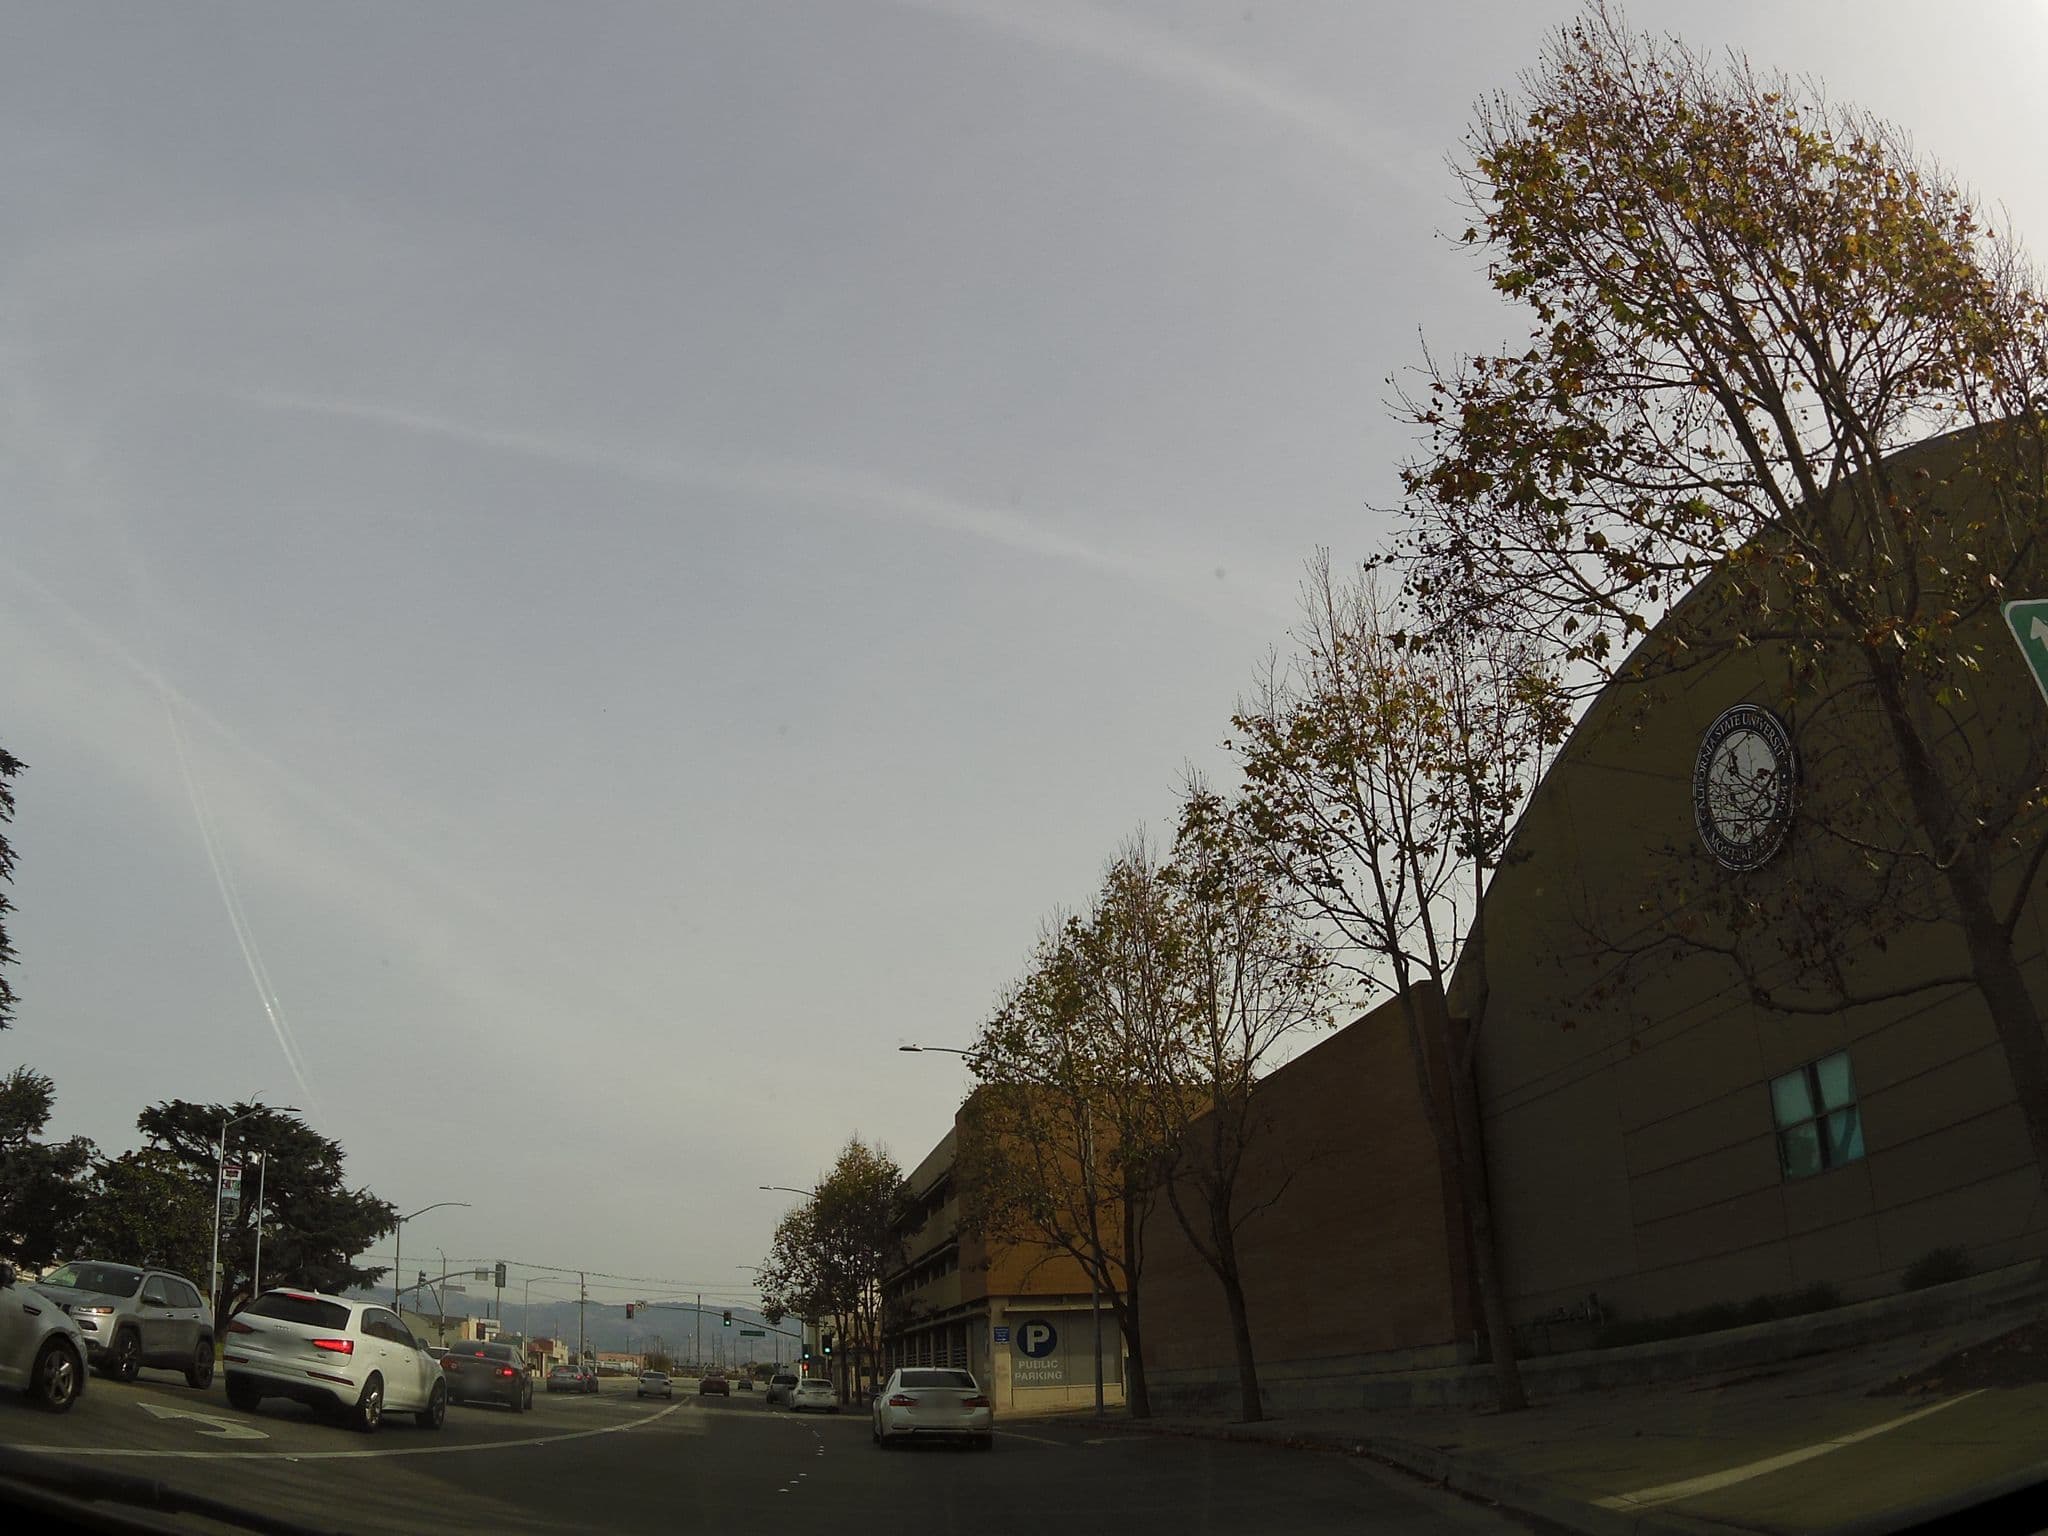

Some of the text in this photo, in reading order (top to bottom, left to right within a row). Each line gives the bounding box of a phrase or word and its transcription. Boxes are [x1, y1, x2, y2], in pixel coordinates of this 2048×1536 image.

[1715, 713, 1741, 737] STATE
[1742, 713, 1787, 761] UNIVERSIT
[1027, 1325, 1049, 1352] P
[1018, 1359, 1058, 1369] PUBLIC
[1014, 1371, 1062, 1381] PARKING
